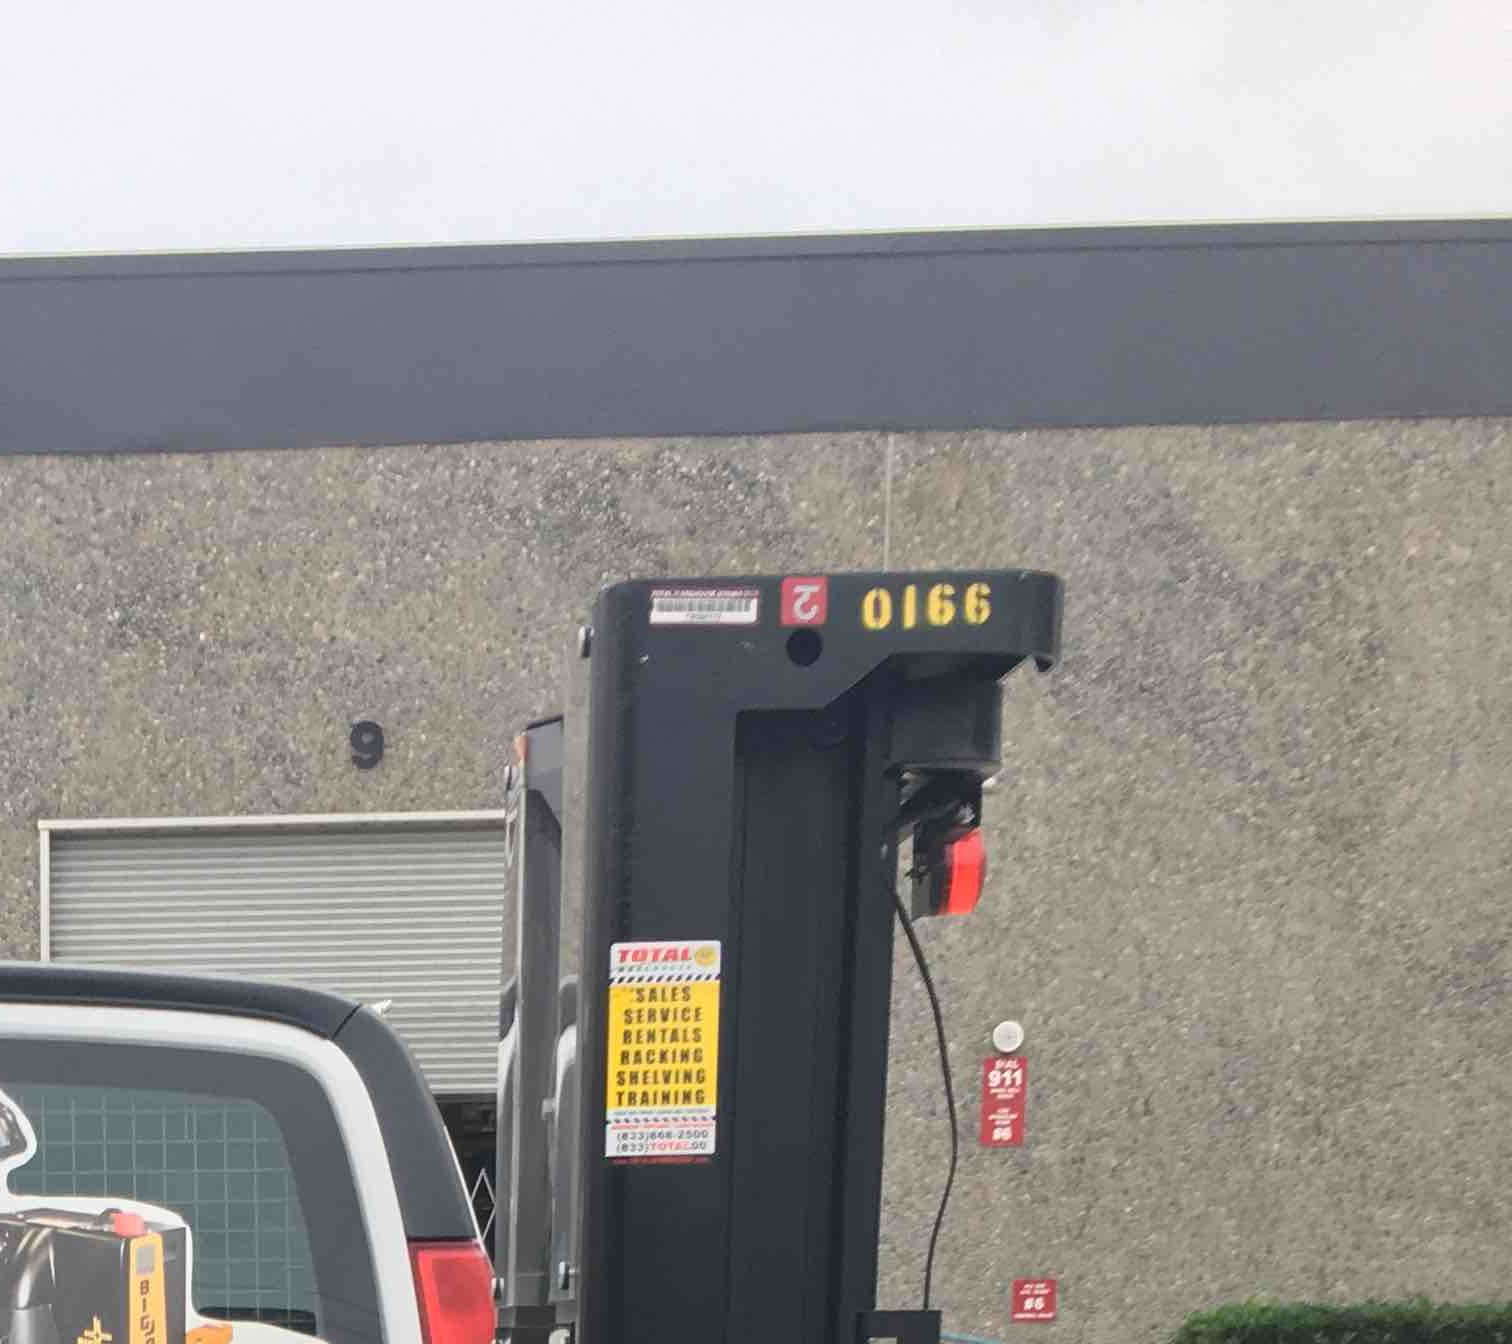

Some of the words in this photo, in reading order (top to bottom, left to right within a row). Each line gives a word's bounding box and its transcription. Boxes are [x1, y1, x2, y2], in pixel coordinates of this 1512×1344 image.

[862, 582, 992, 630] 0166
[350, 720, 385, 770] 9
[617, 946, 692, 964] TOTAL
[635, 985, 692, 1003] SALES
[623, 1007, 703, 1025] SERVICE
[621, 1027, 702, 1045] RENTALS
[619, 1048, 704, 1065] RACKING
[616, 1068, 706, 1086] SHELVING
[988, 1068, 1024, 1088] 911
[616, 1089, 706, 1106] TRAINING
